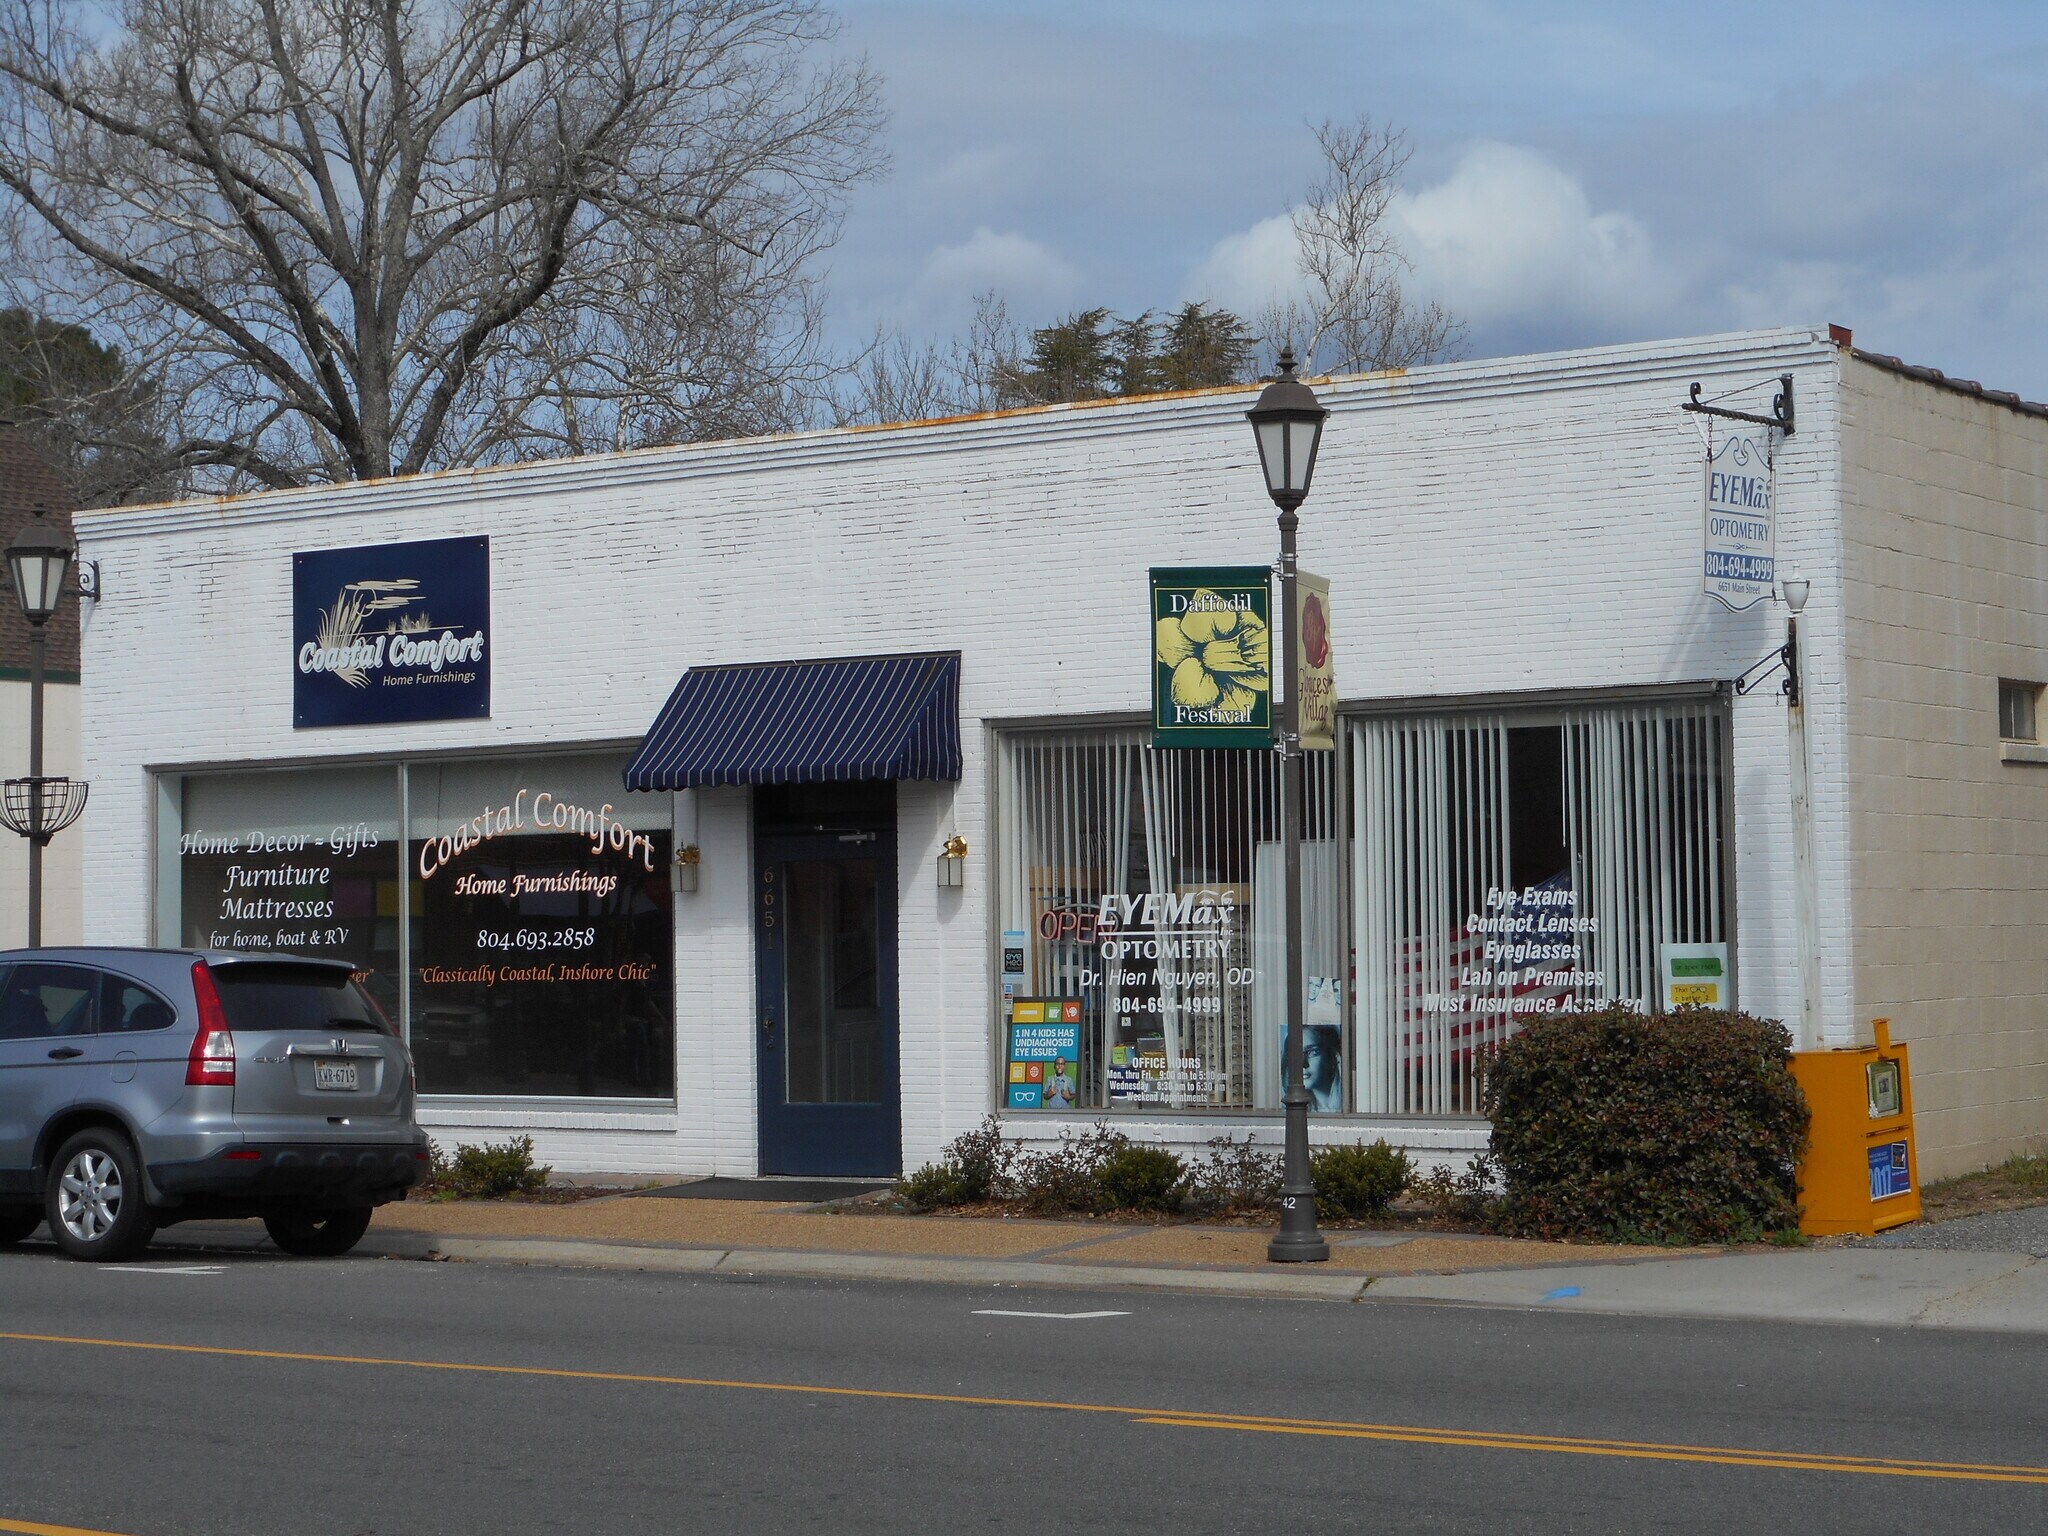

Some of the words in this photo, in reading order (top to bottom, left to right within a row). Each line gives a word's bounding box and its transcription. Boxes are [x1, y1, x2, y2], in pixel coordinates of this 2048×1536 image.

[1709, 472, 1771, 509] EYEMax
[1710, 518, 1770, 541] OPTOMETRY
[1706, 554, 1773, 580] 804-694-4999
[1718, 581, 1730, 592] 6651
[1732, 582, 1745, 593] Main
[1745, 584, 1761, 594] Street
[1169, 593, 1253, 613] Daffodil
[299, 635, 386, 673] Coastal
[389, 630, 484, 672] Comfort
[383, 675, 414, 686] Home
[416, 671, 476, 685] Furnishings
[1173, 705, 1253, 724] Festival
[178, 830, 239, 855] Home
[246, 831, 310, 853] Decor
[330, 822, 379, 857] Gifts
[419, 788, 527, 880] Coastal
[533, 792, 655, 872] Comfort
[222, 863, 330, 893] Furniture
[454, 873, 507, 896] Home
[509, 869, 617, 898] Furnishings
[219, 897, 334, 920] Mattresses
[1098, 891, 1235, 926] EYEMax
[1486, 887, 1517, 911] Eye
[1522, 886, 1578, 906] Exams
[1220, 927, 1235, 937] Inc.
[1466, 913, 1533, 933] Contact
[1537, 914, 1599, 933] Lenses
[209, 930, 230, 949] for
[233, 930, 272, 949] home,
[275, 928, 306, 946] boat
[309, 929, 321, 945] &
[324, 927, 350, 945] RV
[477, 927, 595, 951] 804.693.2858
[1101, 939, 1231, 960] OPTOMETRY
[1484, 940, 1581, 963] Eyeglasses
[419, 964, 496, 987] "Classically
[500, 963, 555, 983] Coastal,
[558, 965, 614, 981] Inshore
[618, 962, 657, 980] Chic"
[1080, 969, 1103, 986] Dr.
[1108, 968, 1146, 986] Hien
[1152, 968, 1220, 989] Nguyen,
[1226, 967, 1255, 985] OD
[1461, 967, 1492, 986] Lab
[1497, 971, 1518, 986] on
[1523, 967, 1604, 986] Premises
[1112, 996, 1221, 1013] 804-694-4999
[1423, 993, 1465, 1013] Most
[1470, 995, 1556, 1013] Insurance
[1015, 1038, 1074, 1047] UNDIAGNOSED
[1021, 1029, 1031, 1038] IN
[1031, 1029, 1038, 1037] 4
[1038, 1029, 1057, 1037] KIDS
[1057, 1029, 1075, 1037] HAS
[1015, 1048, 1030, 1057] EYE
[1031, 1047, 1058, 1056] ISSUES
[1132, 1057, 1166, 1069] OFFICE
[1106, 1070, 1124, 1079] Mon.
[1125, 1070, 1140, 1080] thru
[1141, 1070, 1154, 1080] Fri.
[1159, 1070, 1175, 1080] 9:00
[1189, 1070, 1197, 1080] to
[1109, 1081, 1149, 1092] Wednesday
[1156, 1082, 1172, 1091] 8:30
[1187, 1082, 1194, 1091] to
[1196, 1082, 1213, 1091] 6:30
[1126, 1092, 1159, 1102] Weekend
[1160, 1092, 1208, 1104] Appointments
[1282, 1197, 1296, 1209] 42
